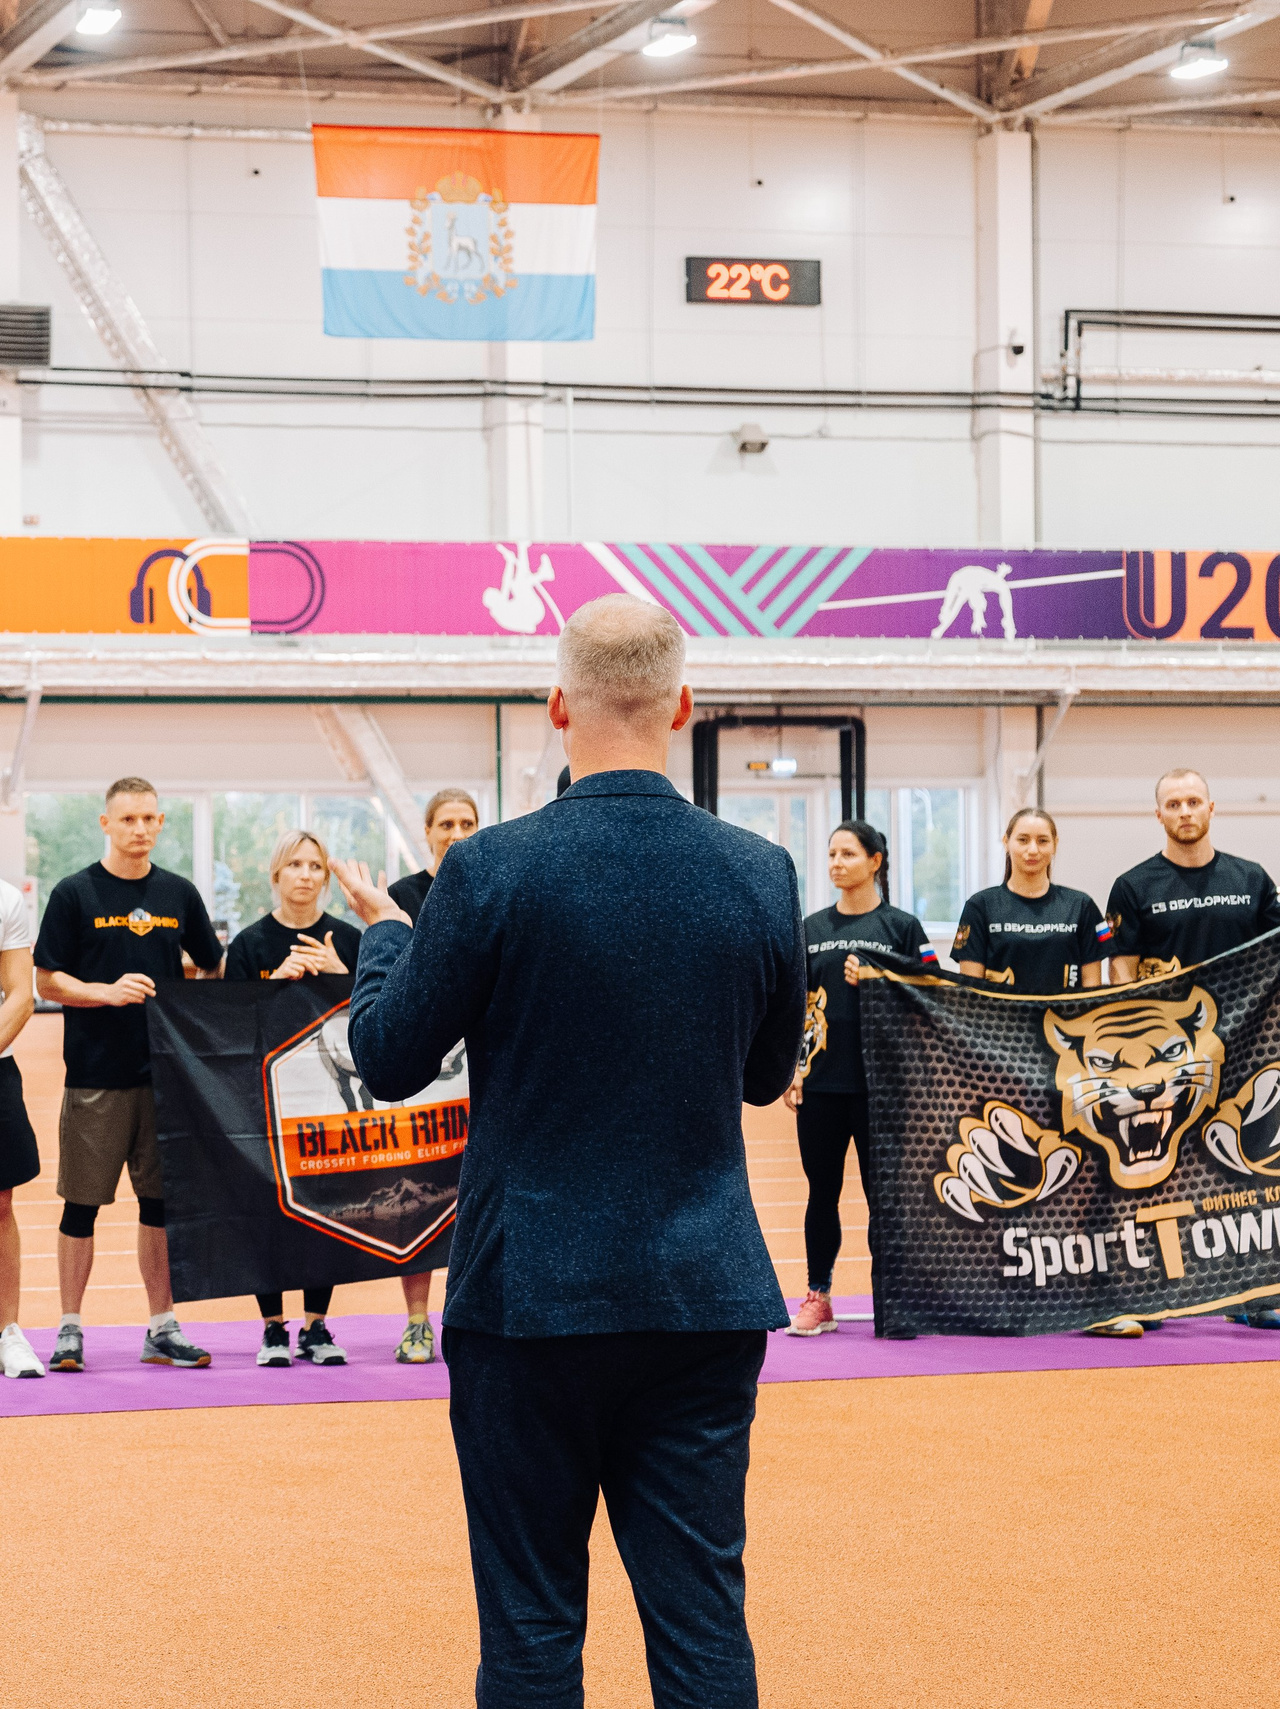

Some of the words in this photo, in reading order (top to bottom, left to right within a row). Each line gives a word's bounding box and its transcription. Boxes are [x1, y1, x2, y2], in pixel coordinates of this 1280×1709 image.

[1122, 550, 1280, 640] U2
[1169, 895, 1251, 911] DEVELOPMENT
[1004, 923, 1078, 933] DEVELOPMENT
[297, 1114, 400, 1157] BLACK
[410, 1104, 469, 1146] RHIN
[300, 1156, 356, 1171] CROSSFIT
[362, 1150, 412, 1165] FORGING
[417, 1144, 447, 1159] ELITE
[1202, 1189, 1258, 1212] ФИТНЕС
